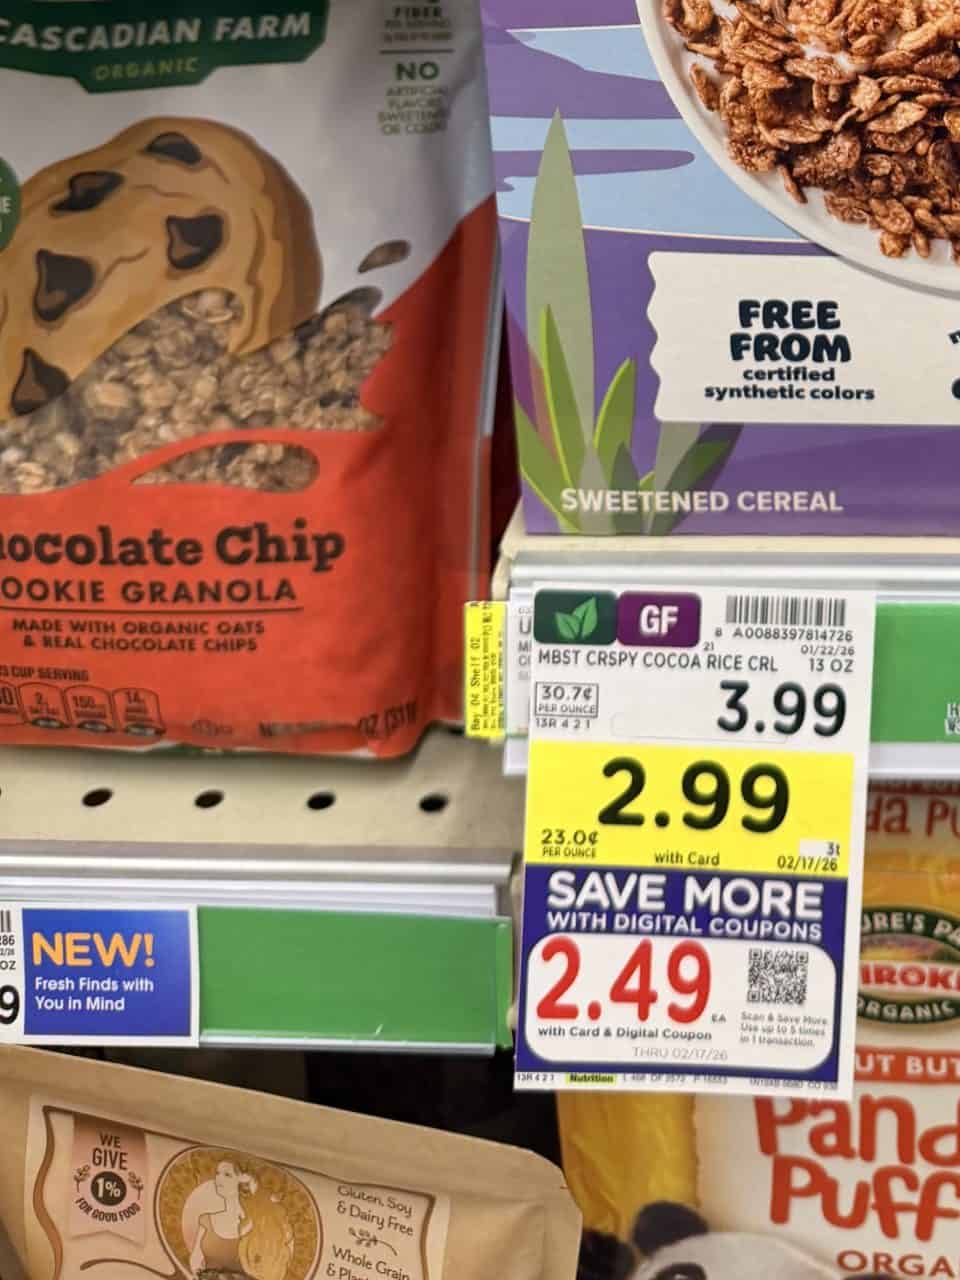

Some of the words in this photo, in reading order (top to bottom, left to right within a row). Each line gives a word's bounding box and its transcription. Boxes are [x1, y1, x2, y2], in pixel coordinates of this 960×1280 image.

[213, 12, 311, 41] FARM
[95, 57, 200, 81] ORGANIC
[396, 61, 440, 81] NO
[738, 299, 840, 330] FREE
[729, 331, 852, 364] FROM
[741, 365, 836, 384] certified
[704, 384, 805, 403] synthetic
[808, 384, 876, 402] colors
[561, 488, 729, 512] SWEETENED
[736, 490, 844, 513] CEREAL
[215, 517, 345, 573] Chip
[121, 577, 297, 603] GRANOLA
[12, 619, 62, 633] MADE
[69, 620, 117, 634] WITH
[122, 621, 210, 635] ORGANIC
[216, 621, 265, 636] OATS
[638, 604, 679, 636] GF
[42, 636, 84, 650] REAL
[90, 637, 196, 652] CHOCOLATE
[203, 638, 258, 653] CHIPS
[538, 649, 581, 666] MBST
[586, 650, 638, 668] CRSPY
[642, 652, 701, 669] COCOA
[706, 654, 743, 671] RICE
[748, 655, 778, 672] CRL
[808, 658, 825, 672] 13
[830, 659, 854, 673] OZ
[541, 684, 593, 701] 30.7¢
[538, 703, 558, 713] PER
[560, 703, 597, 714] OUNCE
[717, 680, 848, 738] 3.99
[598, 756, 790, 835] 2.99
[541, 829, 599, 846] 23.0¢
[542, 846, 562, 858] PER
[564, 846, 597, 859] OUNCE
[654, 851, 684, 865] with
[687, 852, 721, 867] Card
[777, 855, 839, 872] 02/17/26
[547, 870, 667, 911] SAVE
[684, 875, 824, 919] MORE
[547, 912, 607, 931] WITH
[613, 914, 703, 934] DIGITAL
[709, 920, 823, 940] COUPONS
[32, 931, 155, 967] NEW!
[35, 977, 75, 991] Fresh
[79, 977, 119, 992] Finds
[122, 977, 154, 992] with
[536, 933, 712, 1025] 2.49
[35, 997, 63, 1011] You
[68, 996, 82, 1010] in
[86, 996, 125, 1011] Mind
[711, 1014, 727, 1023] EA
[538, 1026, 565, 1038] with
[569, 1026, 600, 1038] Card
[603, 1027, 612, 1038] &
[615, 1027, 659, 1041] Digital
[662, 1028, 713, 1042] Coupon
[632, 1046, 668, 1059] THRU
[670, 1046, 728, 1061] 02/17/26
[569, 1072, 614, 1083] Nutrition
[99, 1133, 121, 1149] WE
[92, 1147, 128, 1171] GIVE
[96, 1177, 121, 1198] 1%
[337, 1184, 385, 1208] Gluten,
[387, 1195, 413, 1219] Soy
[336, 1200, 347, 1214] &
[349, 1203, 385, 1231] Dairy
[387, 1215, 414, 1237] Free
[331, 1243, 373, 1270] Whole
[326, 1261, 336, 1277] &
